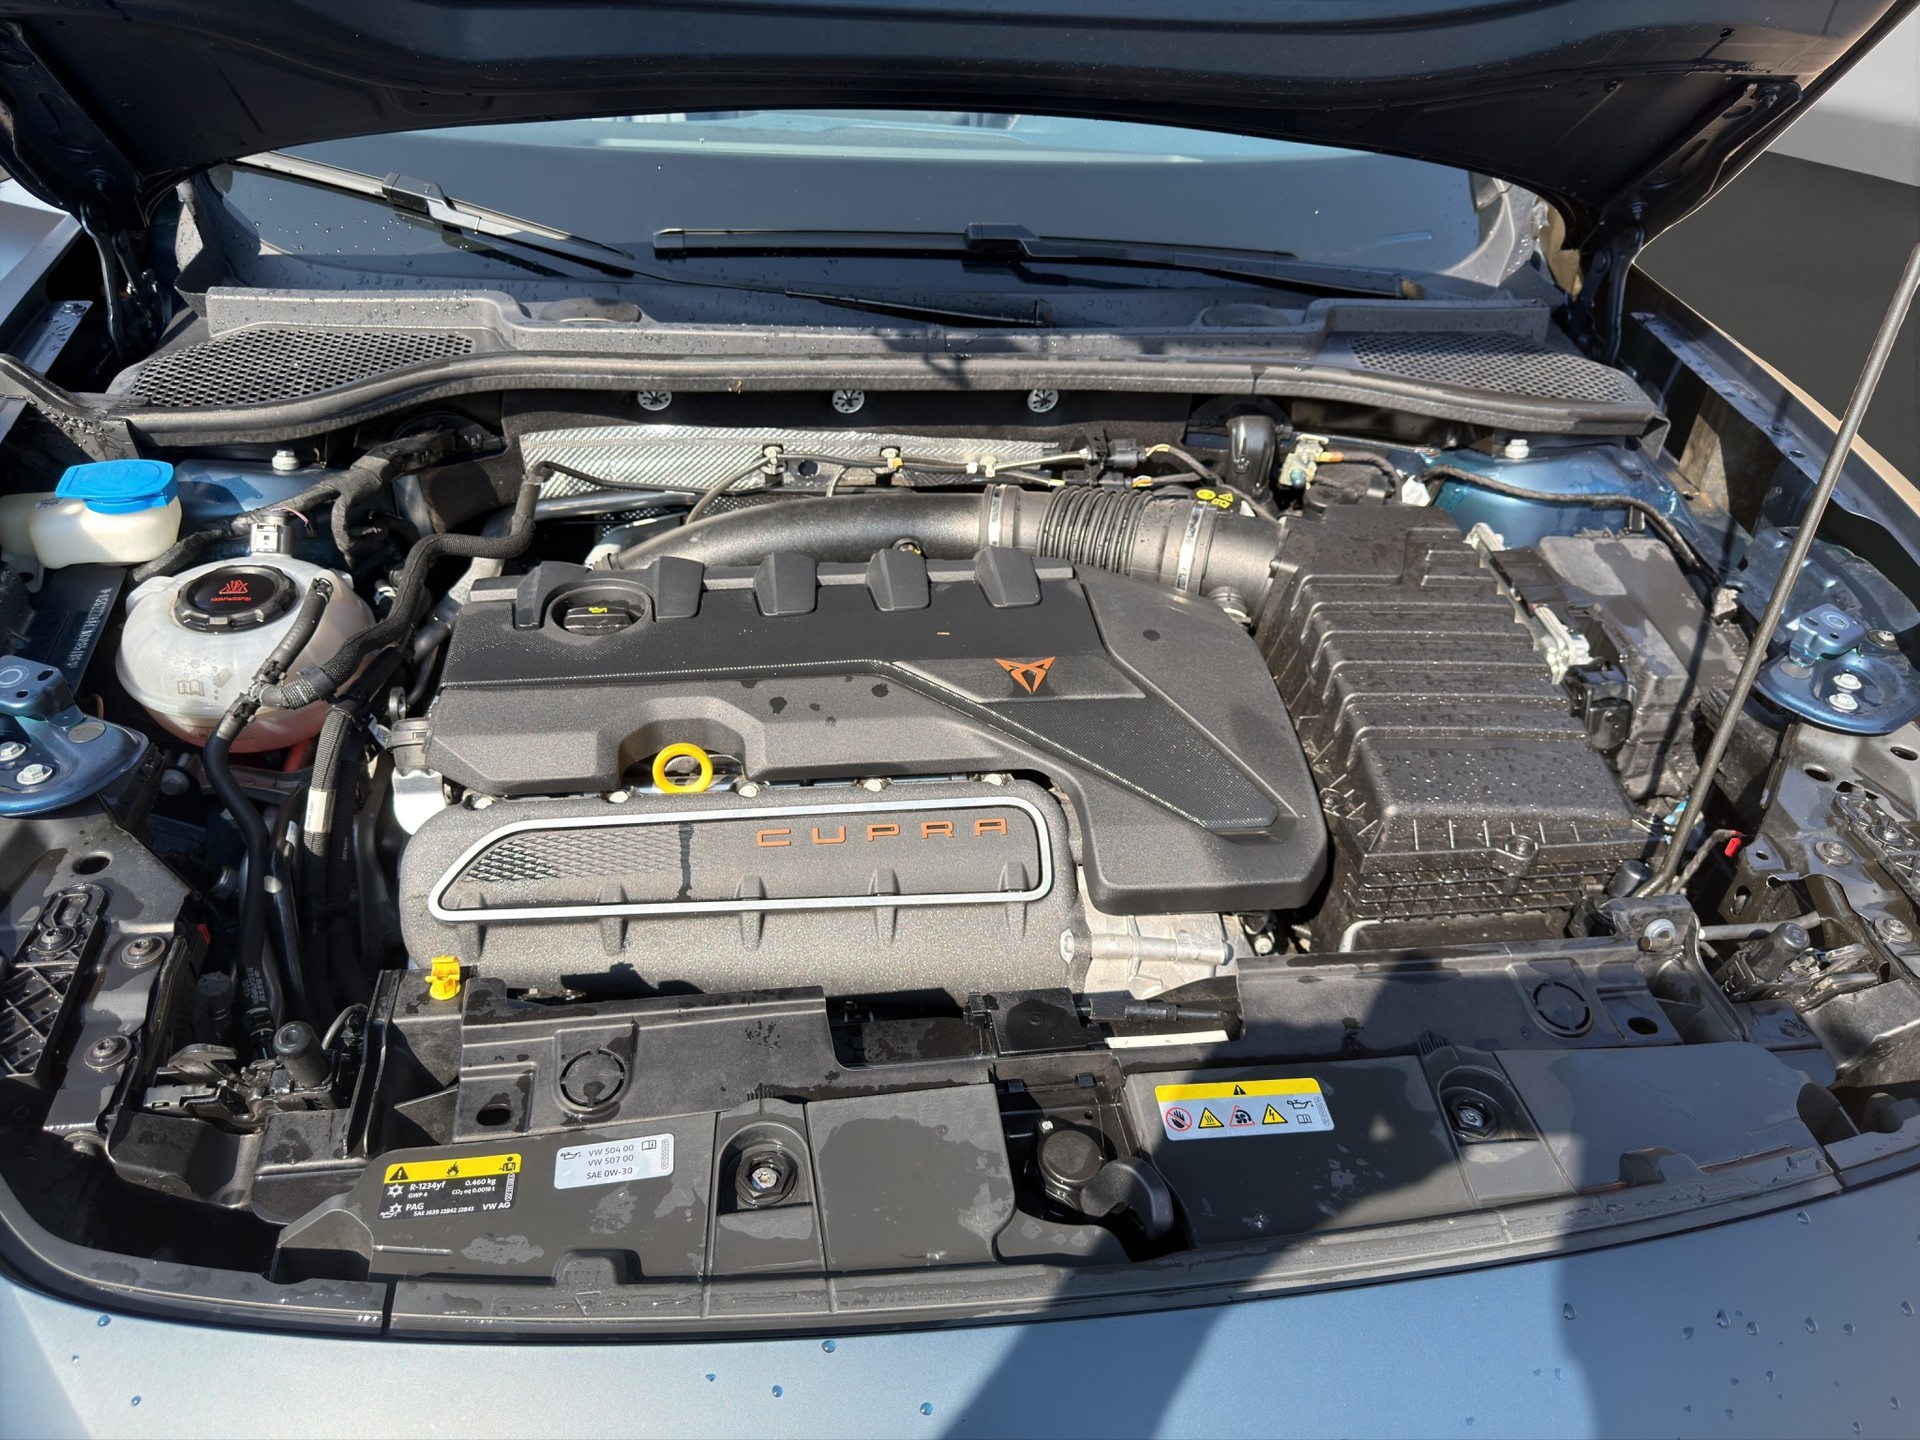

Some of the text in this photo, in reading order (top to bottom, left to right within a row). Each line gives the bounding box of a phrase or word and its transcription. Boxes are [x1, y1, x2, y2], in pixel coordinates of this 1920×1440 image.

[756, 817, 1009, 847] CUPRA
[588, 1144, 635, 1157] VW 504 00
[587, 1154, 634, 1167] VW 507 00
[586, 1167, 632, 1179] SAE 0W-30
[409, 1181, 446, 1191] R-1234yf
[487, 1177, 497, 1185] kg
[405, 1203, 424, 1211] PAG
[482, 1201, 511, 1211] VW AG
